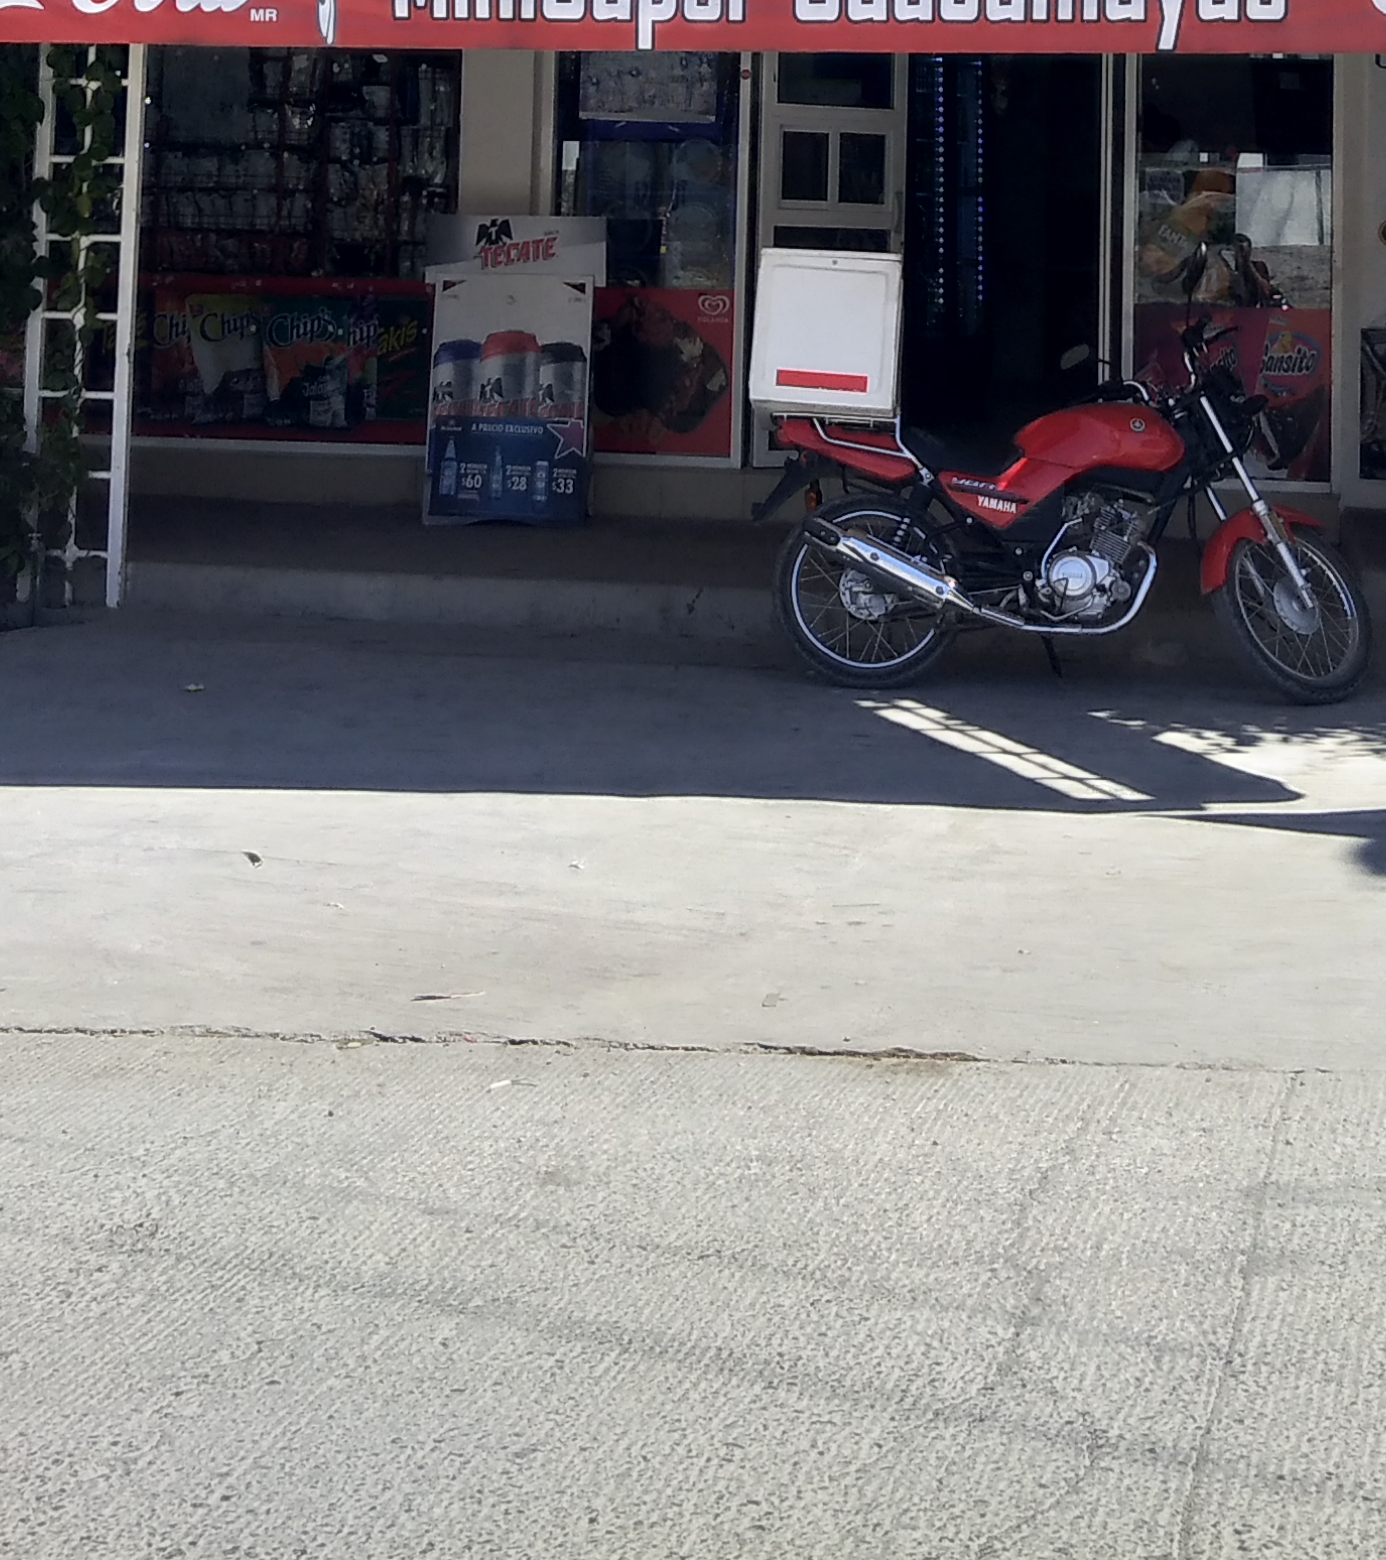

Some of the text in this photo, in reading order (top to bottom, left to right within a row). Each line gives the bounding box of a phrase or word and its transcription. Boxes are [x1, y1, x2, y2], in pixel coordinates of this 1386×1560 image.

[249, 8, 279, 23] MR
[480, 236, 558, 269] TECATE
[377, 320, 419, 357] akis
[977, 495, 1017, 514] YAMAHA
